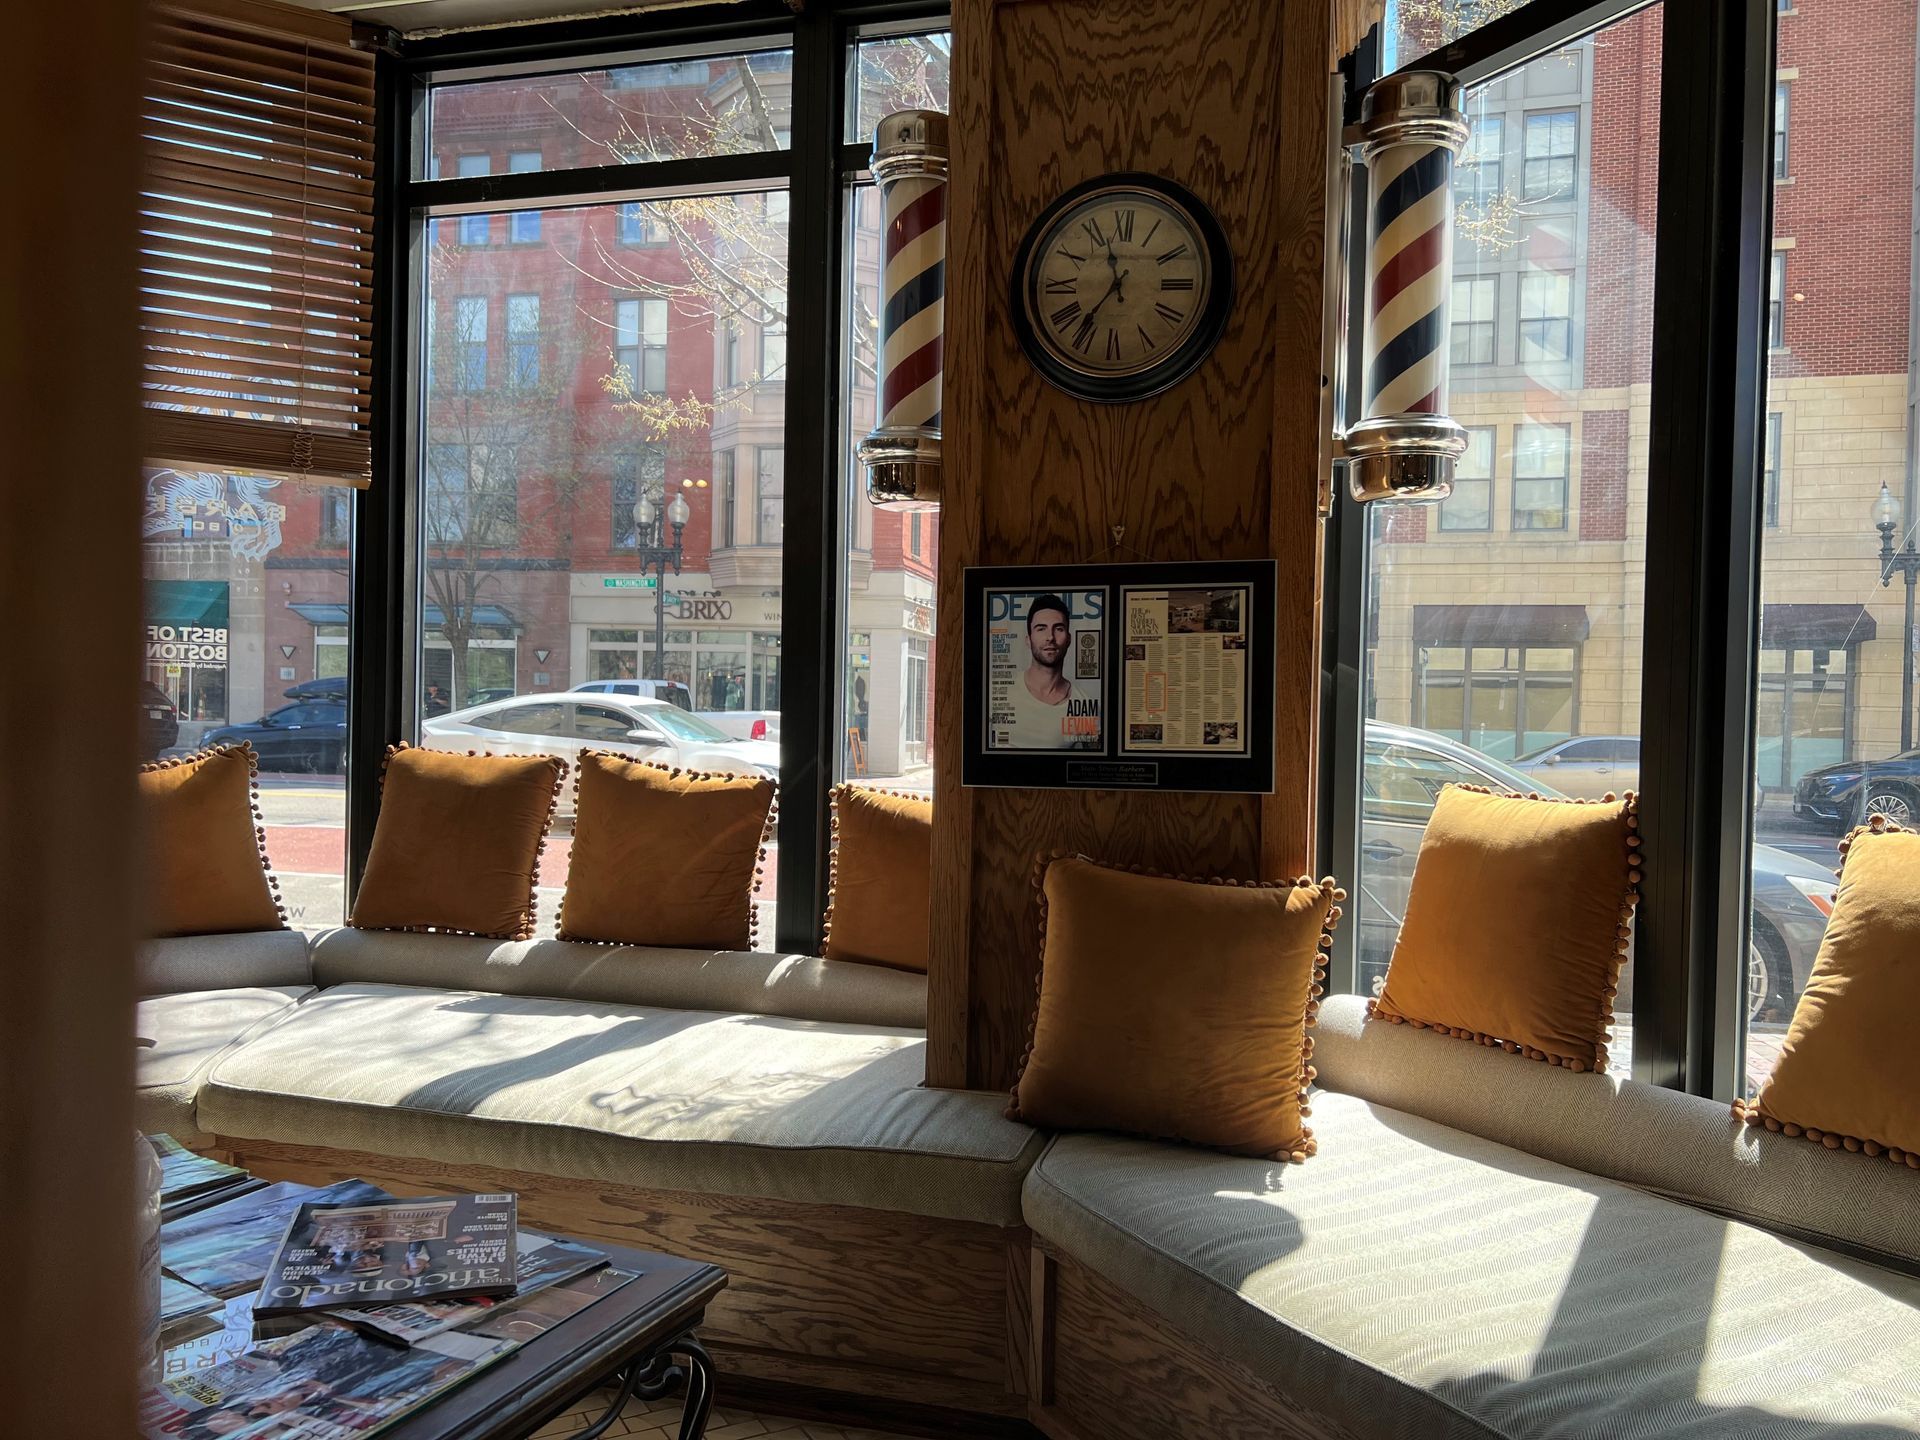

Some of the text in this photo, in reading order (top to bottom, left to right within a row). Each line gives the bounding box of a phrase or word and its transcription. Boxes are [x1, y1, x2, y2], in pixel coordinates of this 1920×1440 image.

[679, 600, 727, 620] BRIX
[1066, 699, 1098, 717] ADAM
[446, 1246, 506, 1256] FAMILIES
[271, 1267, 500, 1307] aficionado
